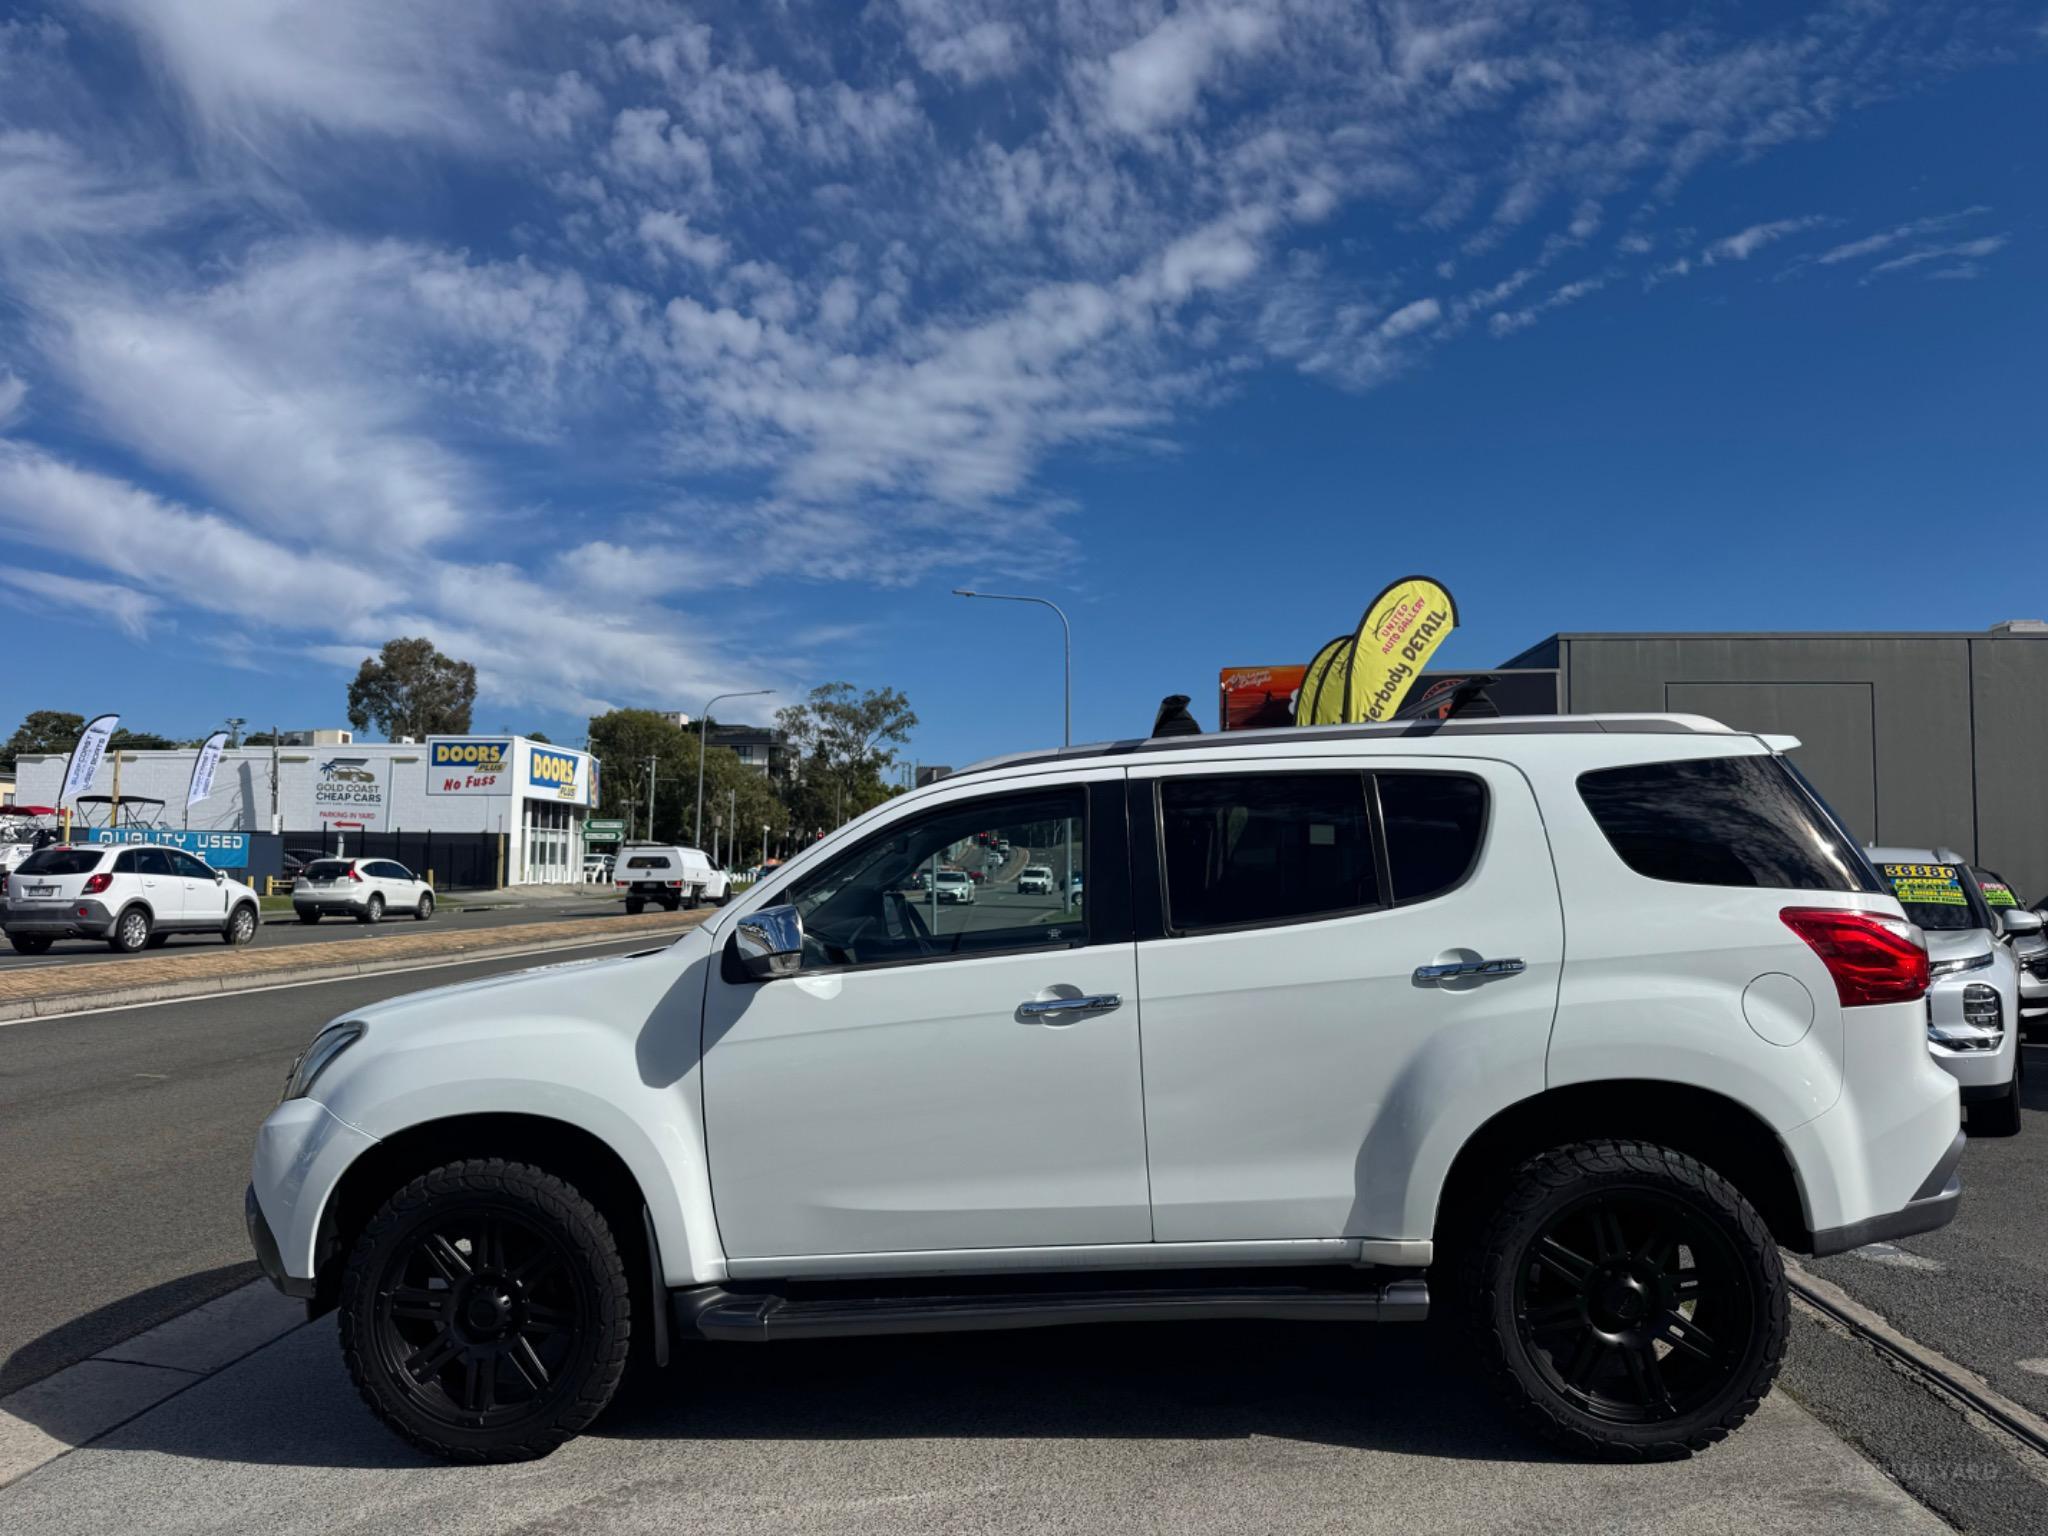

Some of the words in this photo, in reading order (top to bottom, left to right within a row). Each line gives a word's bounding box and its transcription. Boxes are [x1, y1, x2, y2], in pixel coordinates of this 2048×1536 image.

[1381, 603, 1409, 638] UNITED
[1382, 632, 1400, 655] AUTO
[1398, 596, 1426, 635] GALLERY
[1401, 610, 1448, 663] DETAIL
[436, 745, 501, 763] DOORS
[478, 763, 505, 772] PLUS
[533, 753, 574, 784] DOORS
[316, 783, 344, 793] GOLD
[346, 784, 380, 793] COAST
[443, 778, 461, 791] No
[465, 775, 496, 789] Fuss
[559, 785, 576, 797] PLUS
[316, 792, 351, 801] CHEAP
[353, 793, 382, 803] CARS
[99, 831, 187, 848] QUALITY
[197, 834, 243, 849] USED
